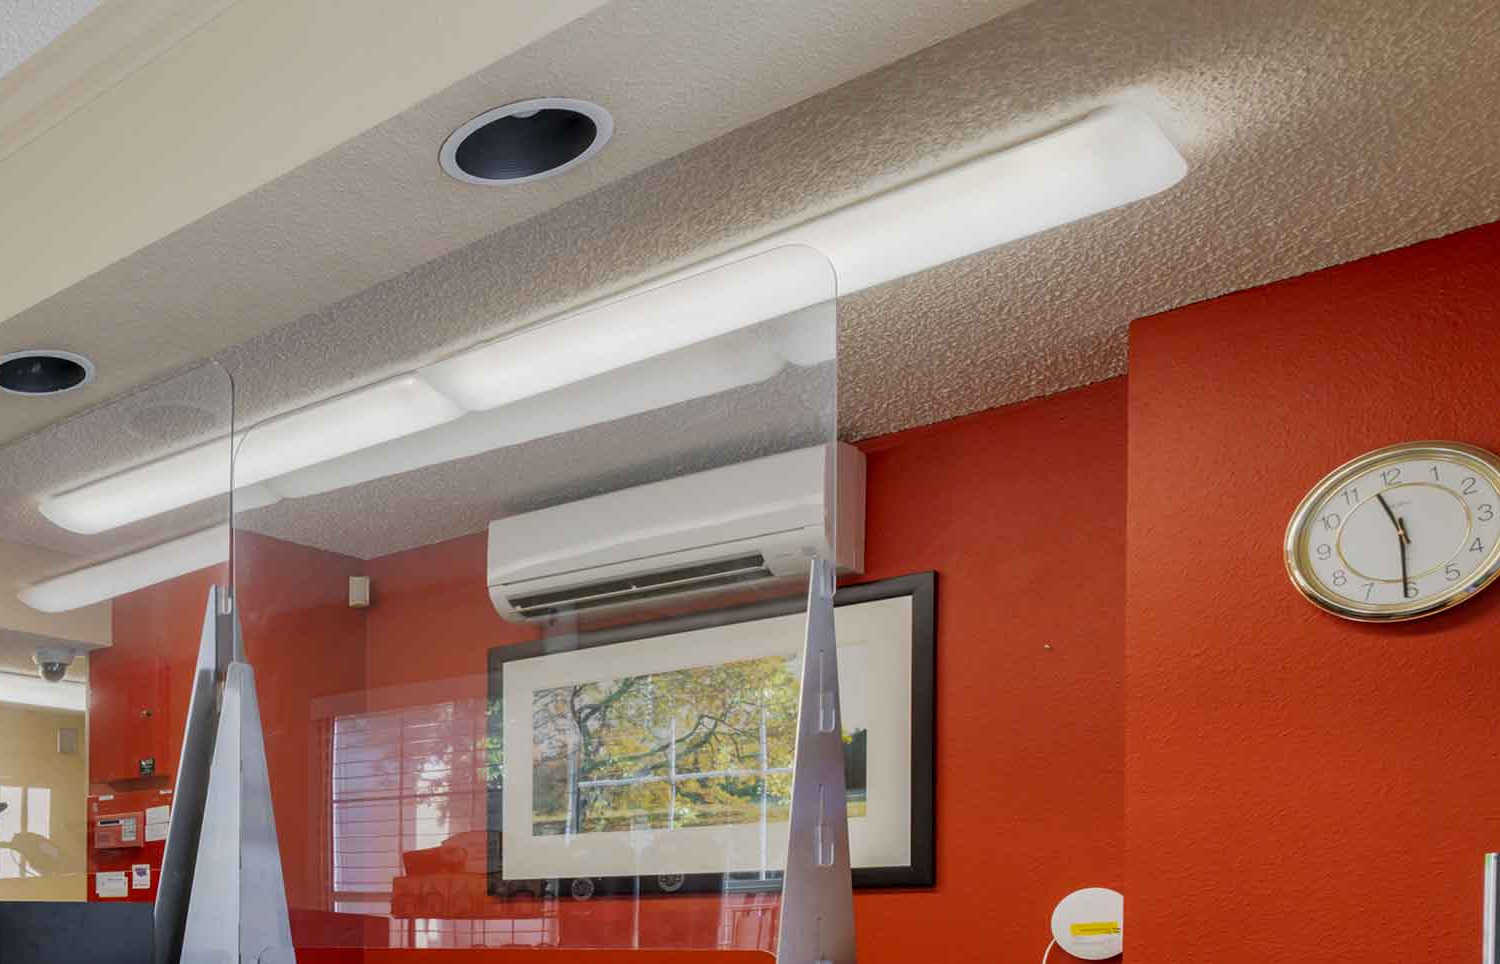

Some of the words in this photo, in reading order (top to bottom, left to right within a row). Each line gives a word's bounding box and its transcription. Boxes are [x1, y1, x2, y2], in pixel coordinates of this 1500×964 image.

[1380, 468, 1401, 486] 12
[1429, 466, 1440, 482] 1
[1460, 476, 1478, 496] 2
[1342, 488, 1360, 505] 11
[1321, 512, 1341, 531] 10
[1476, 503, 1494, 522] 3
[1316, 543, 1332, 560] 9
[1468, 537, 1485, 553] 4
[1332, 569, 1348, 587] 8
[1444, 563, 1461, 582] 5
[1362, 582, 1375, 601] 7
[1404, 579, 1419, 599] 6
